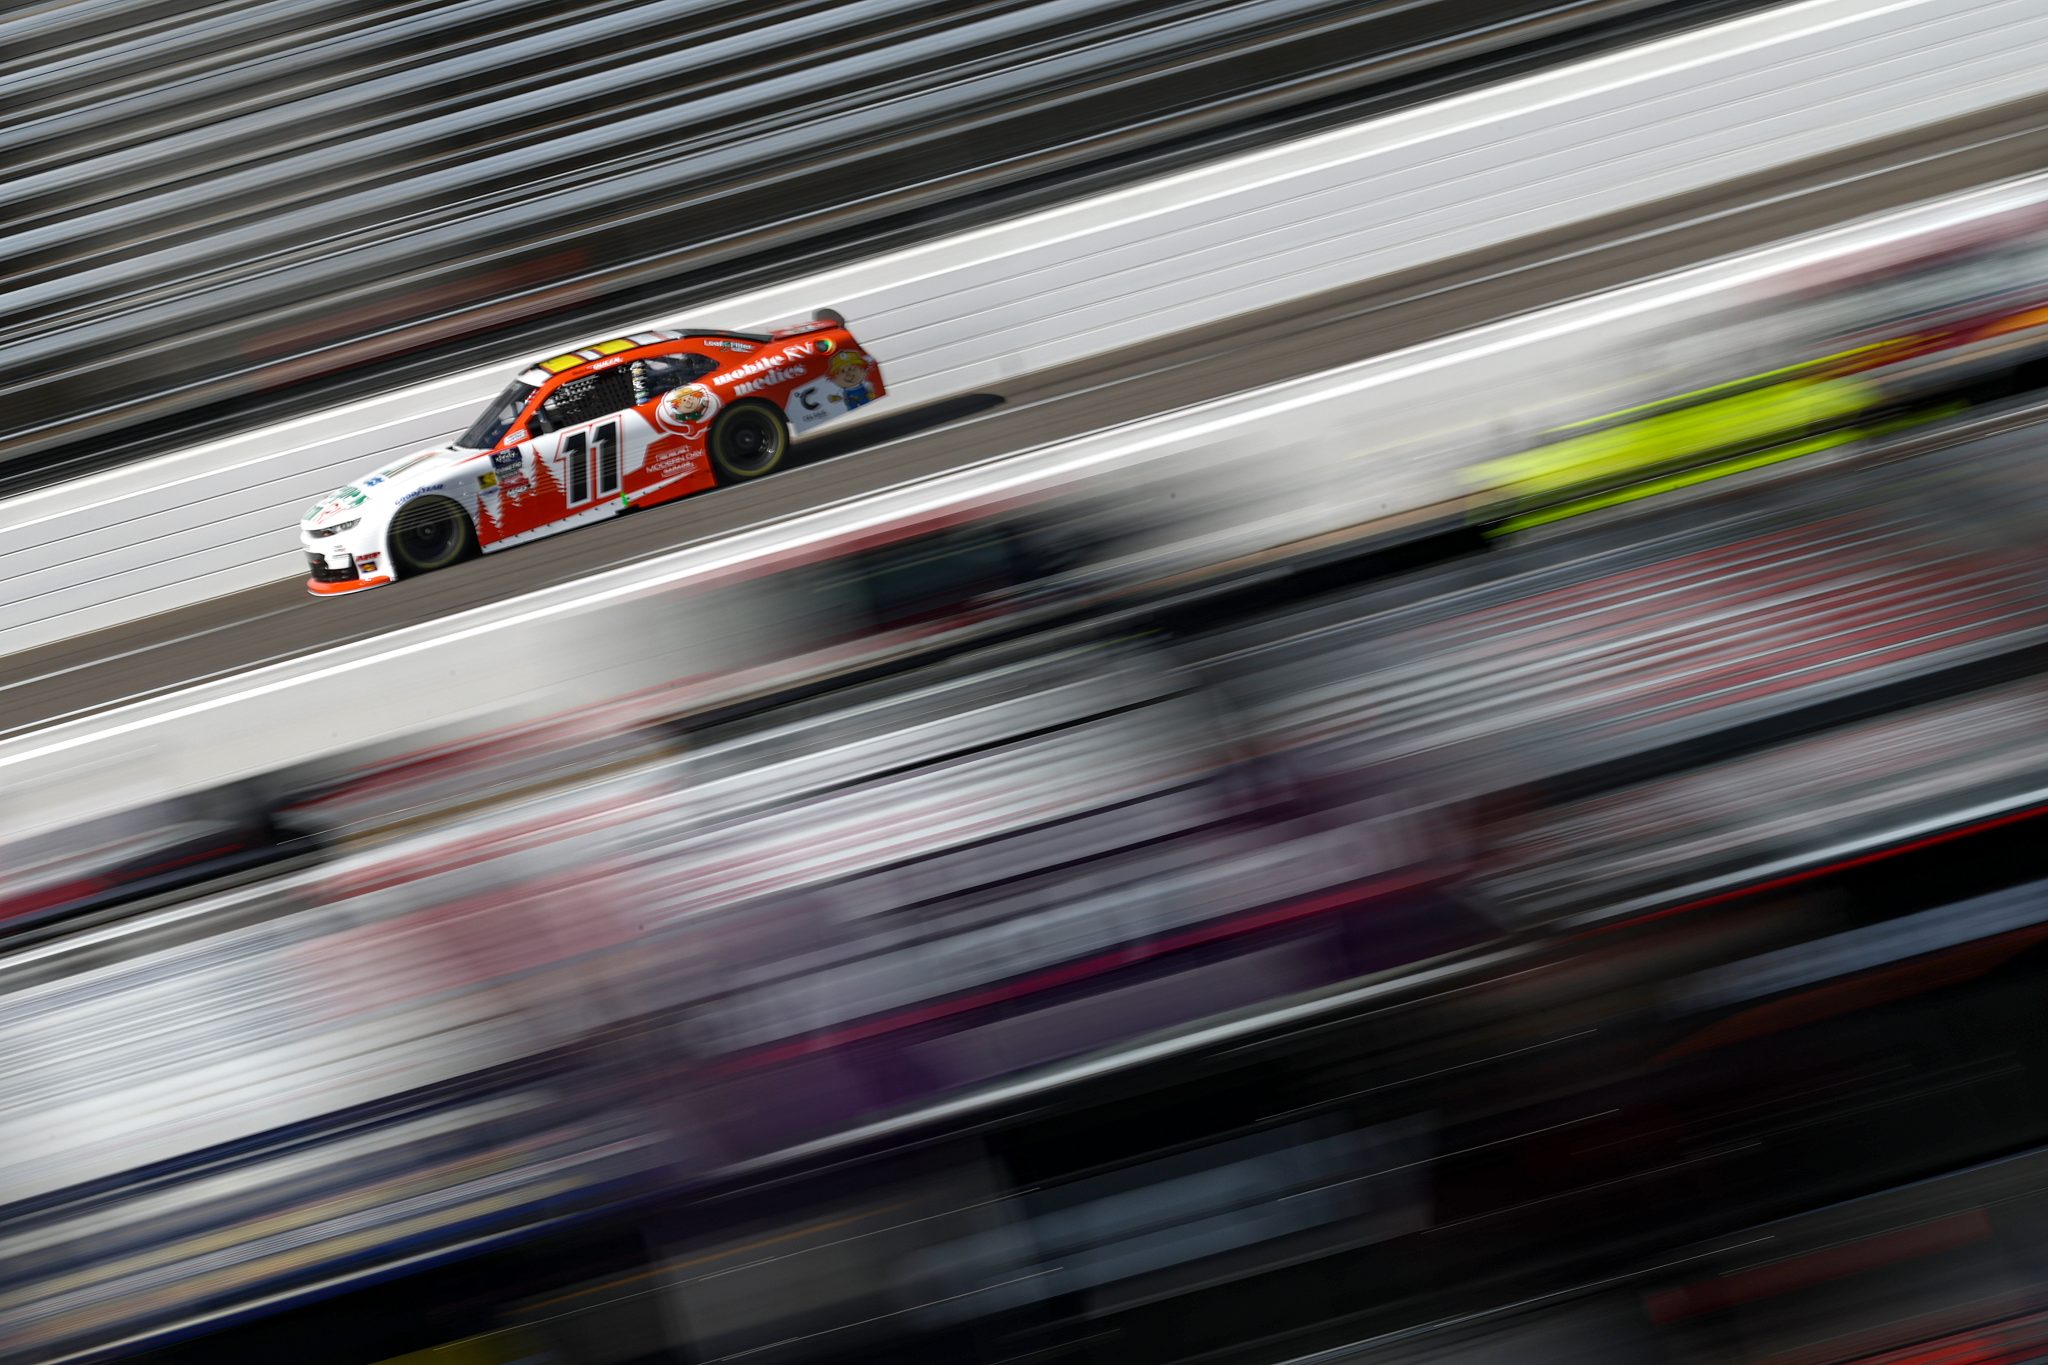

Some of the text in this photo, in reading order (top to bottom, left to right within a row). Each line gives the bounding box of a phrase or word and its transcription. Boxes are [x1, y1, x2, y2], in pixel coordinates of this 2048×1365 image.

[712, 341, 817, 387] mobile RV
[733, 363, 806, 396] medics
[557, 416, 622, 508] 11
